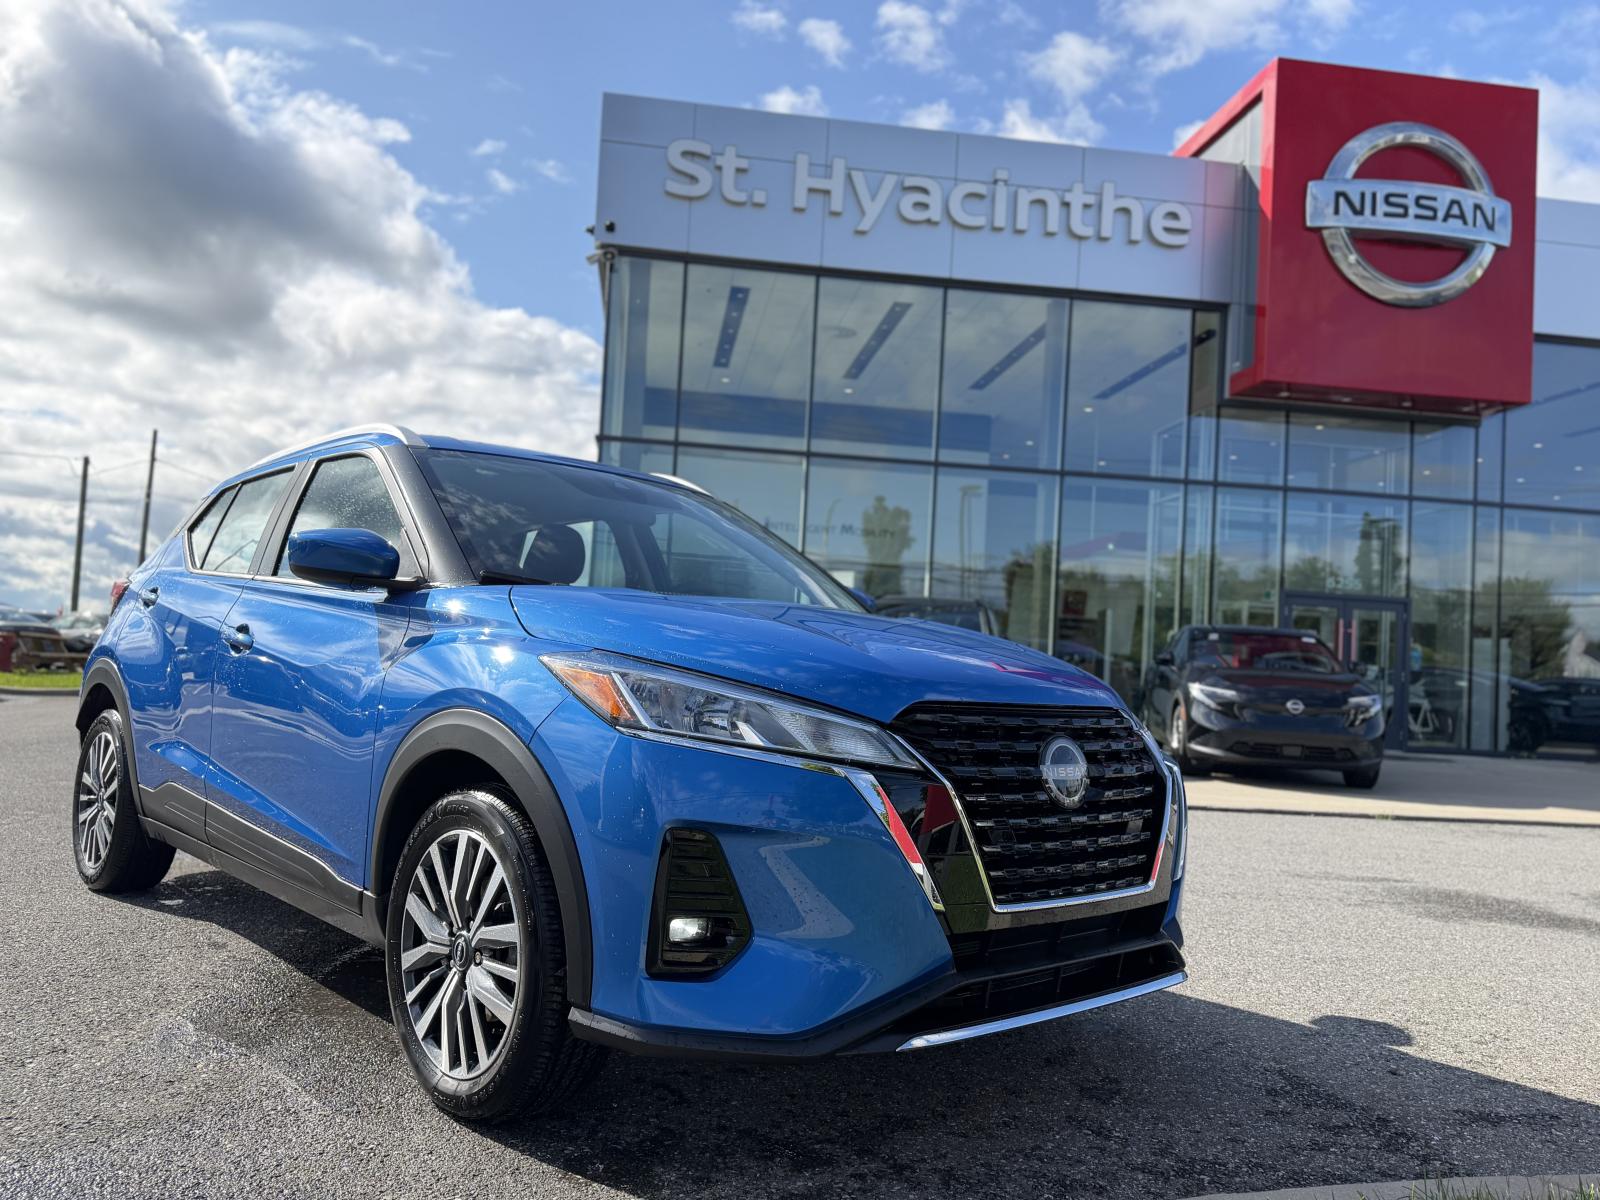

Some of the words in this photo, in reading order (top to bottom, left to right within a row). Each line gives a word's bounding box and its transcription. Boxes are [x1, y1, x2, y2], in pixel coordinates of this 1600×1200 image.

[664, 138, 767, 206] St.
[793, 152, 1193, 248] Hyacinthe
[1333, 190, 1496, 232] NISSAN
[1044, 766, 1087, 778] NISSAN
